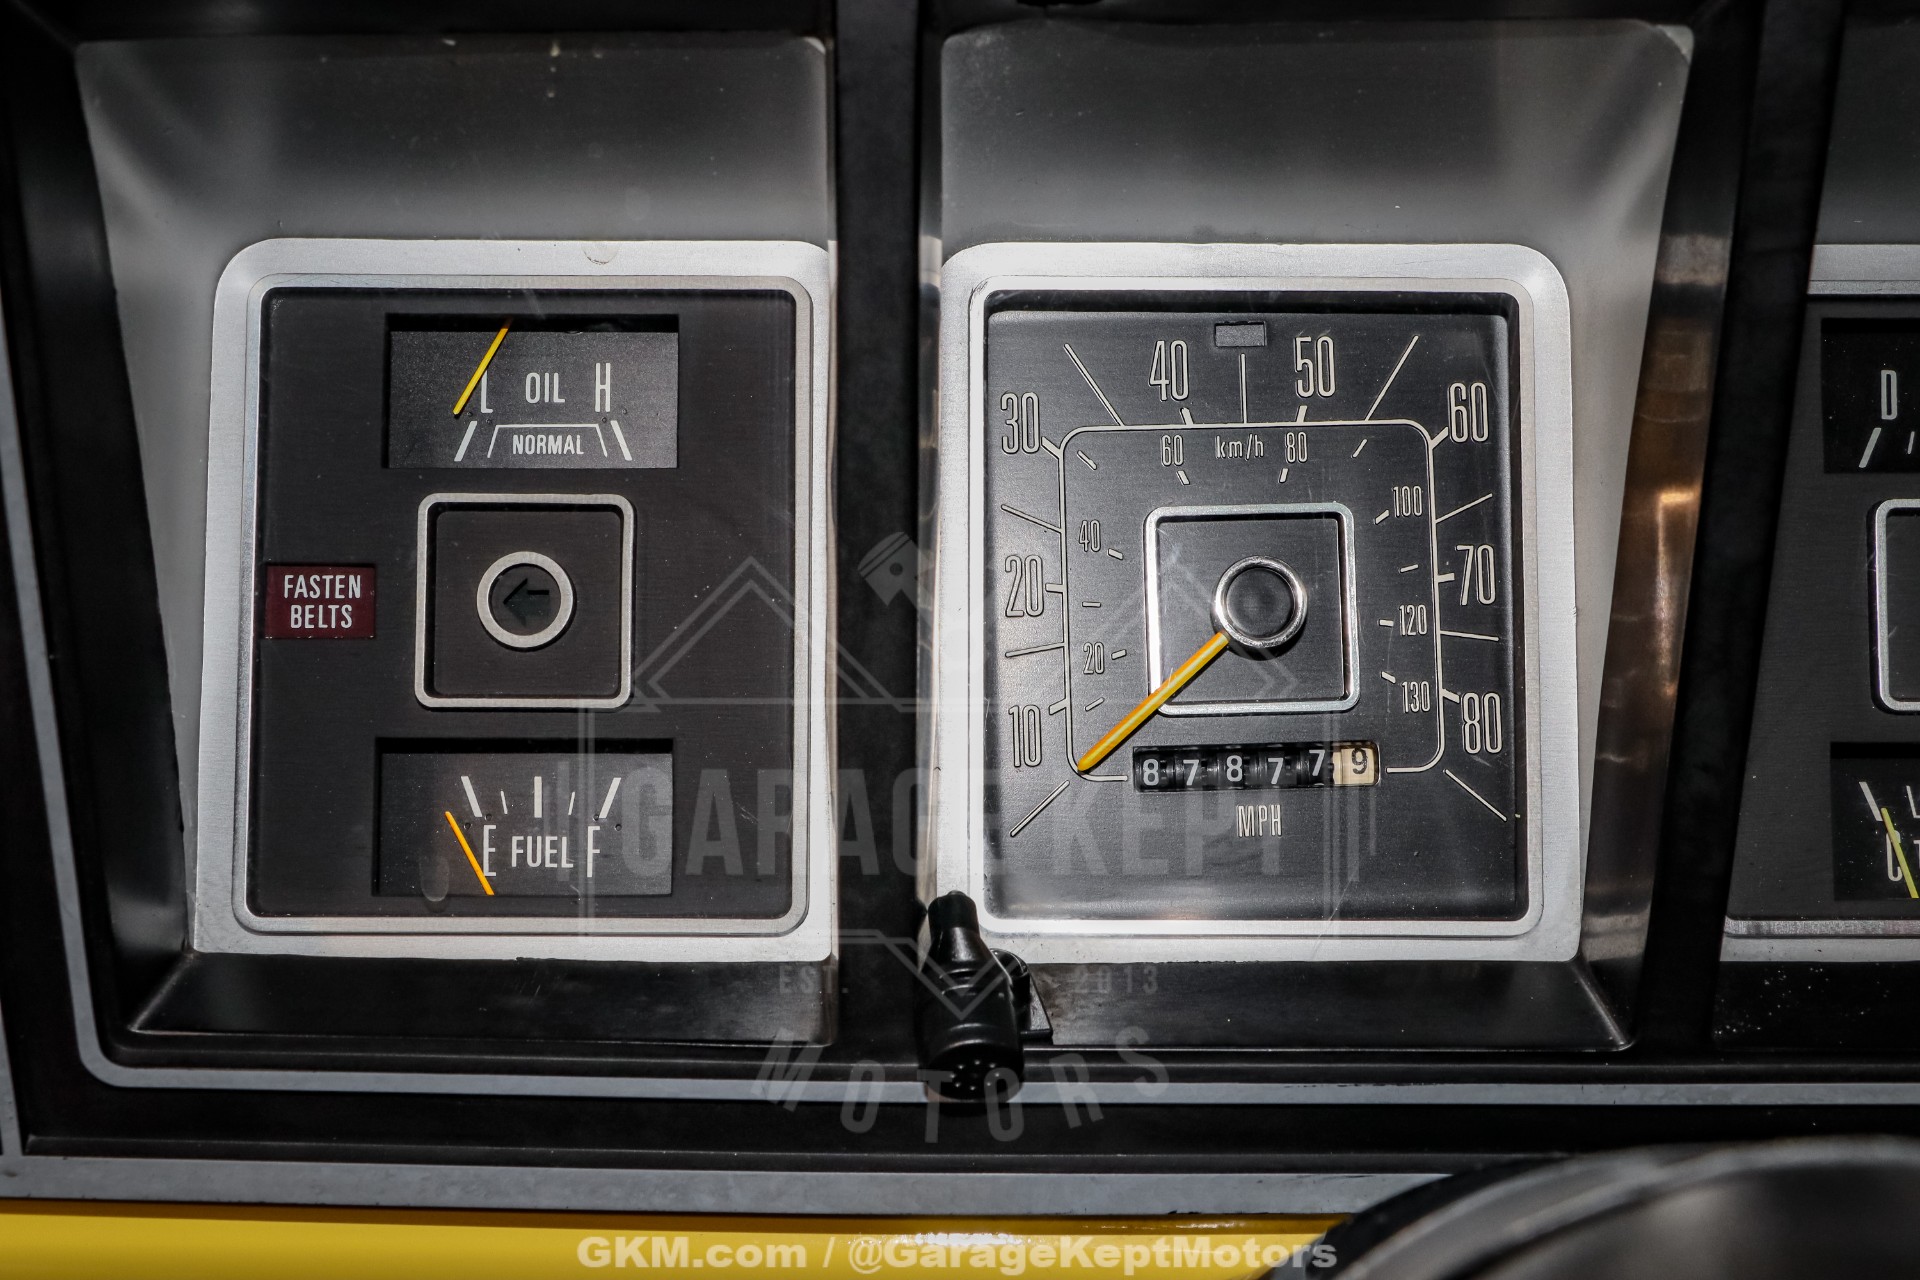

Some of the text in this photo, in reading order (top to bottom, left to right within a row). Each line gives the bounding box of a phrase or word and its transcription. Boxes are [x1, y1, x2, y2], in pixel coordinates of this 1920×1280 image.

[1149, 340, 1189, 401] 40
[1295, 336, 1336, 398] 50
[480, 362, 611, 414] L OIL H
[1880, 369, 1898, 421] D
[1001, 392, 1040, 454] 30
[1447, 382, 1488, 443] 60
[512, 434, 585, 455] NORMAL
[1160, 435, 1184, 466] 60
[1215, 435, 1265, 459] km/h
[1285, 432, 1308, 463] 80
[1393, 485, 1422, 516] 100
[1079, 520, 1101, 553] 40
[283, 574, 362, 600] FASTEN
[1005, 555, 1043, 617] 20
[1456, 544, 1495, 605] 70
[290, 604, 353, 630] BELTS
[1400, 605, 1428, 637] 120
[1083, 642, 1104, 675] 20
[1402, 681, 1431, 713] 130
[1009, 704, 1042, 767] 10
[1462, 692, 1503, 754] 80
[1237, 804, 1283, 838] MPH
[482, 824, 601, 878] E FUEL F
